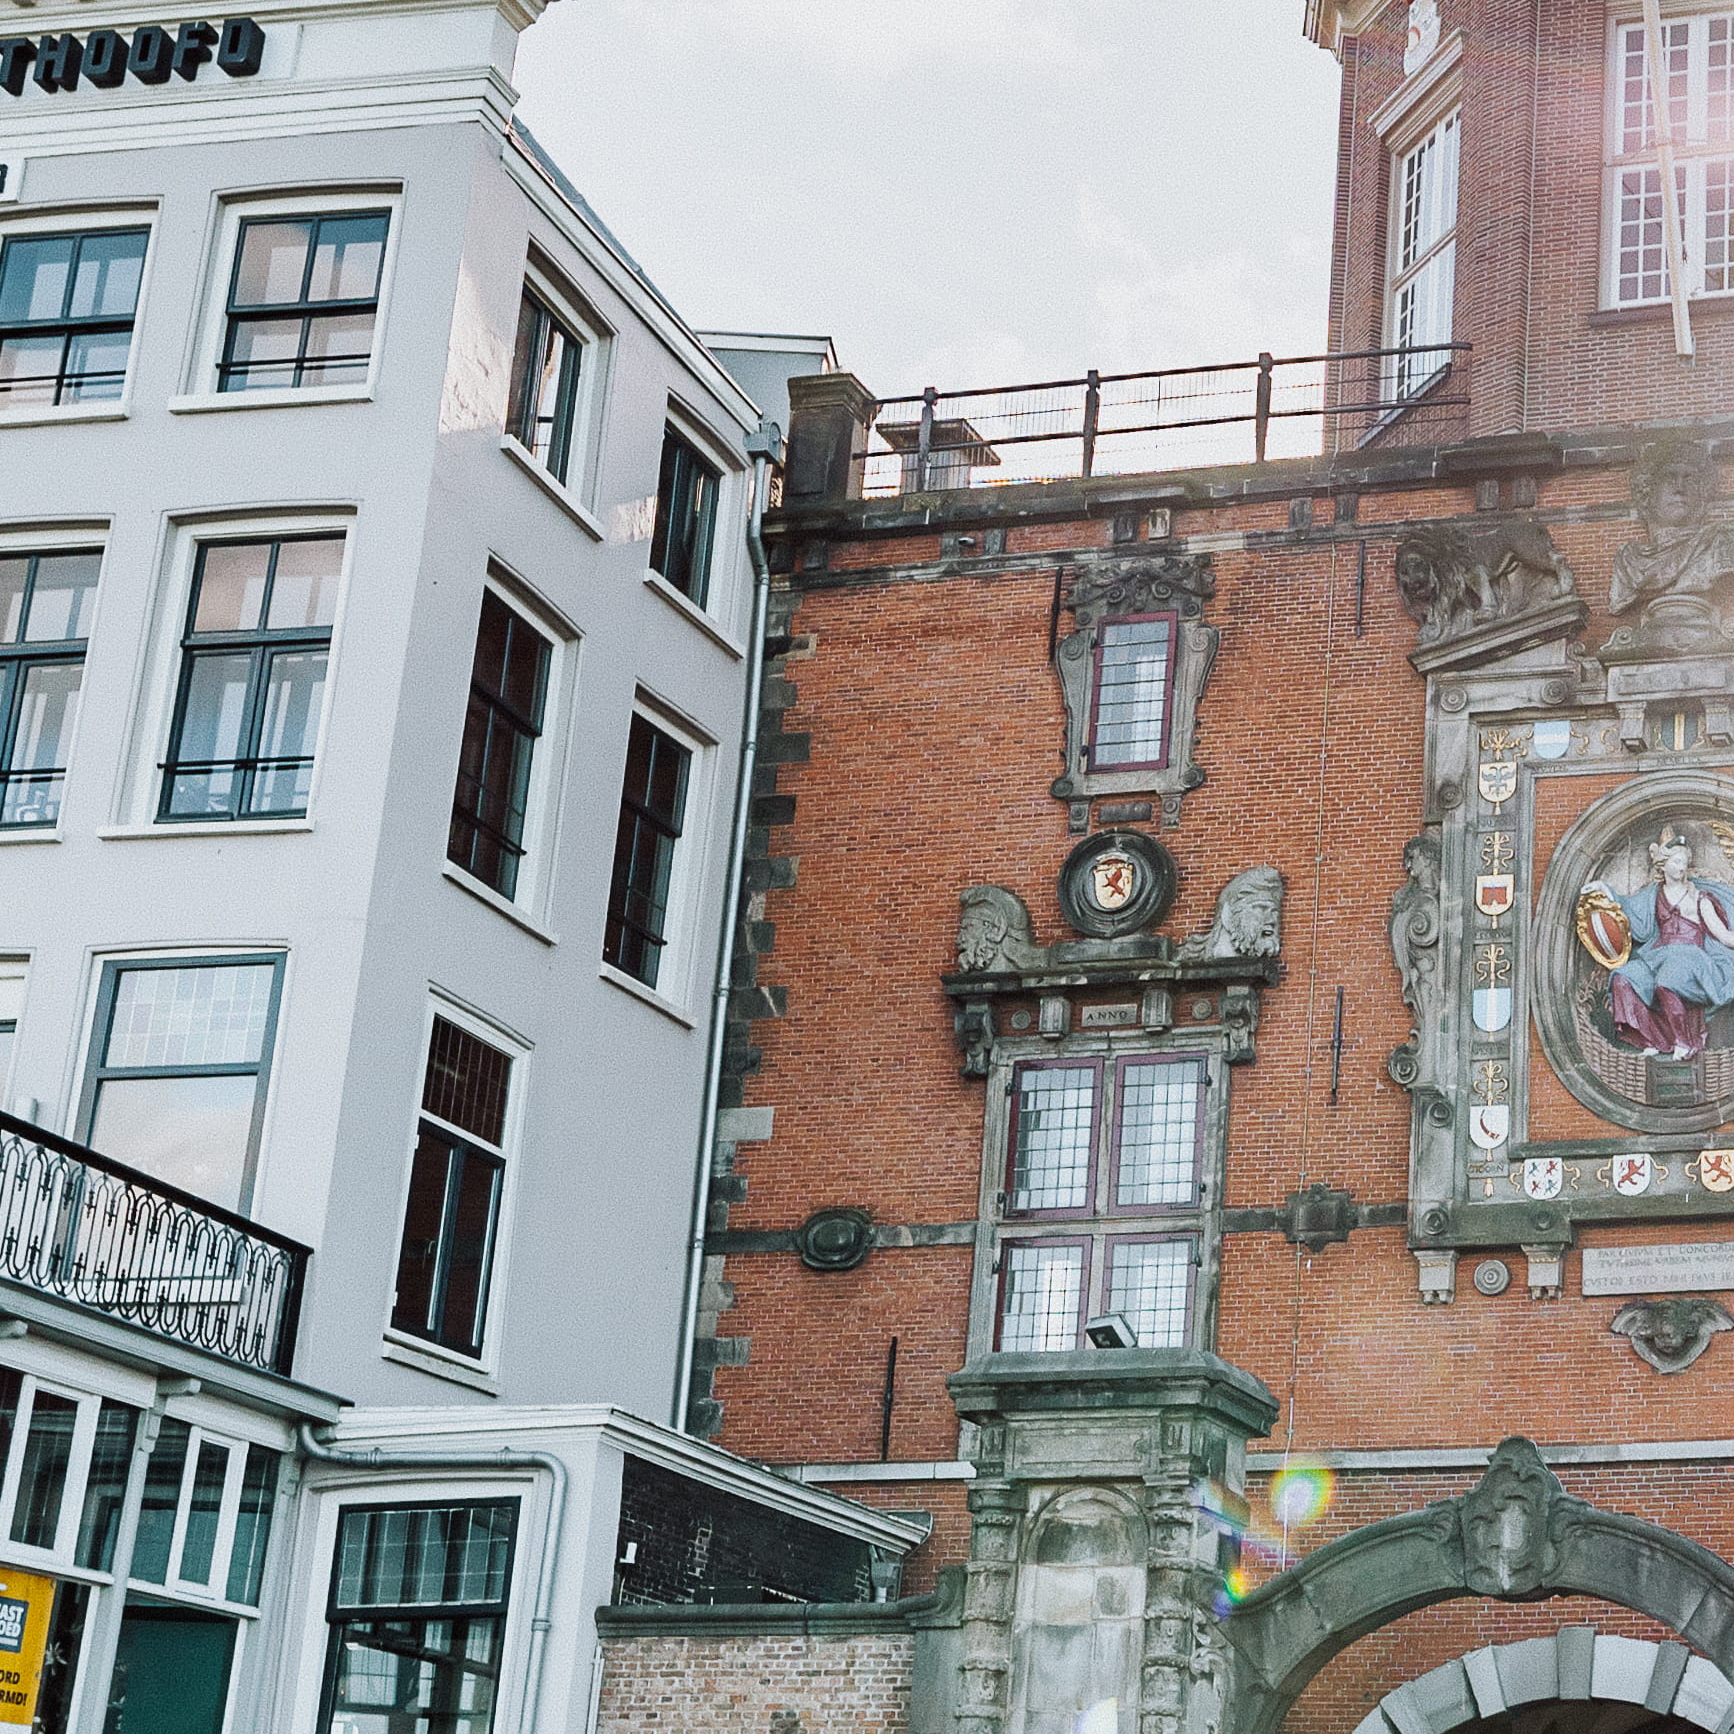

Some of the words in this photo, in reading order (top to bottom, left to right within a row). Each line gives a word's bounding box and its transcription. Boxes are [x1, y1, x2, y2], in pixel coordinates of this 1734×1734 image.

[0, 17, 265, 96] THOOFD
[1086, 1010, 1128, 1021] ANNO
[0, 1603, 25, 1624] AST
